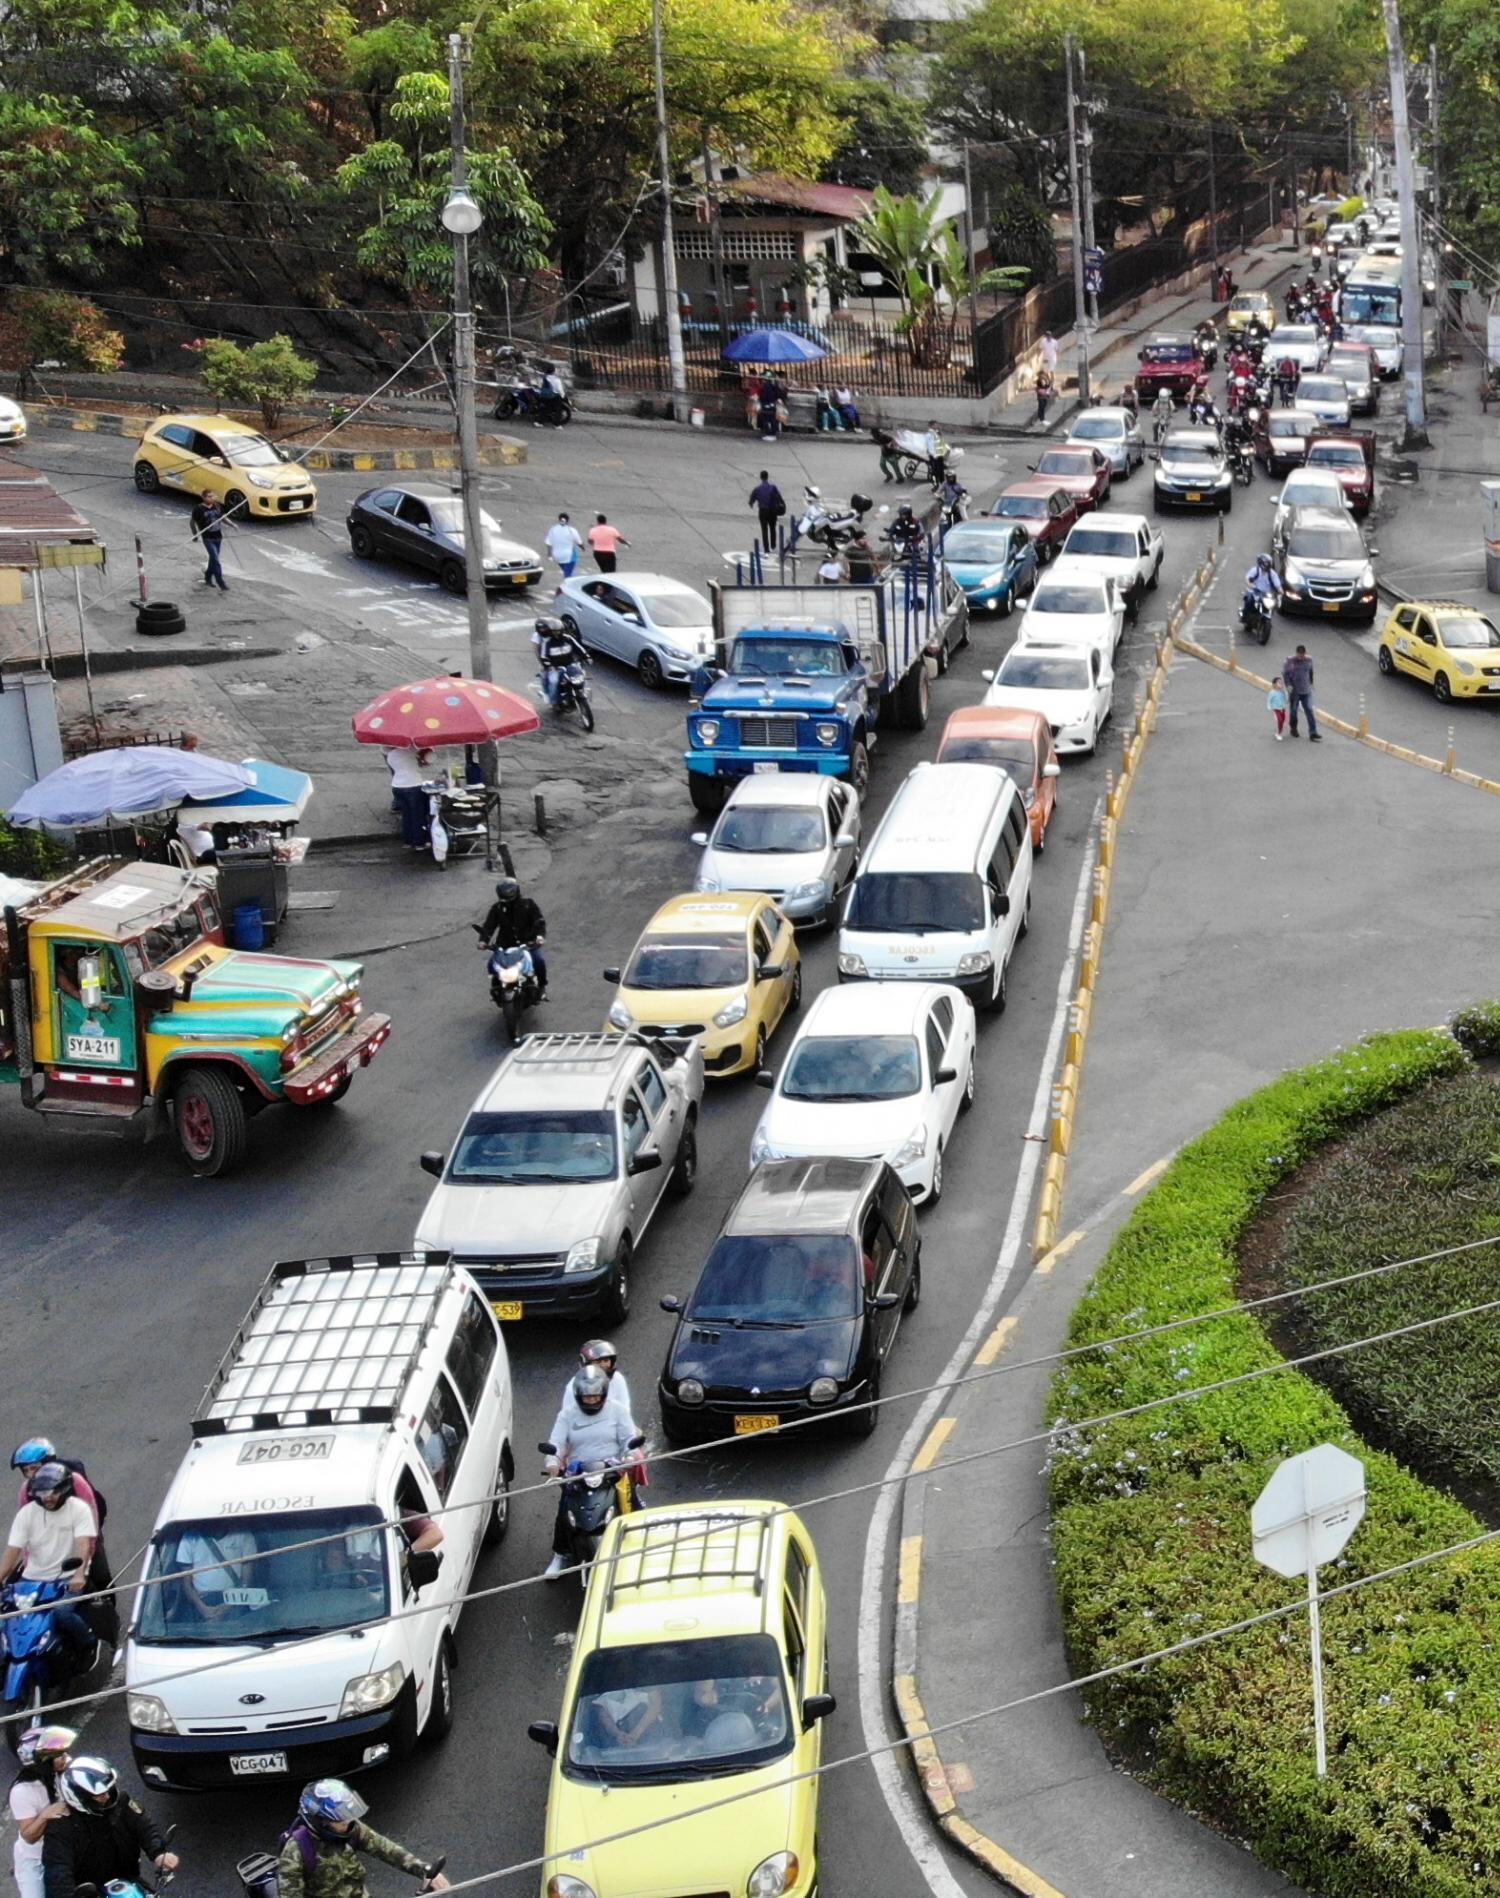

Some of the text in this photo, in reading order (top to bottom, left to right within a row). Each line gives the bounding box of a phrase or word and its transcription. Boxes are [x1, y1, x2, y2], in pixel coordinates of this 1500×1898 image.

[69, 1038, 115, 1054] SYA-211
[241, 1442, 328, 1463] VCG-047
[231, 1755, 284, 1771] VCG-047
